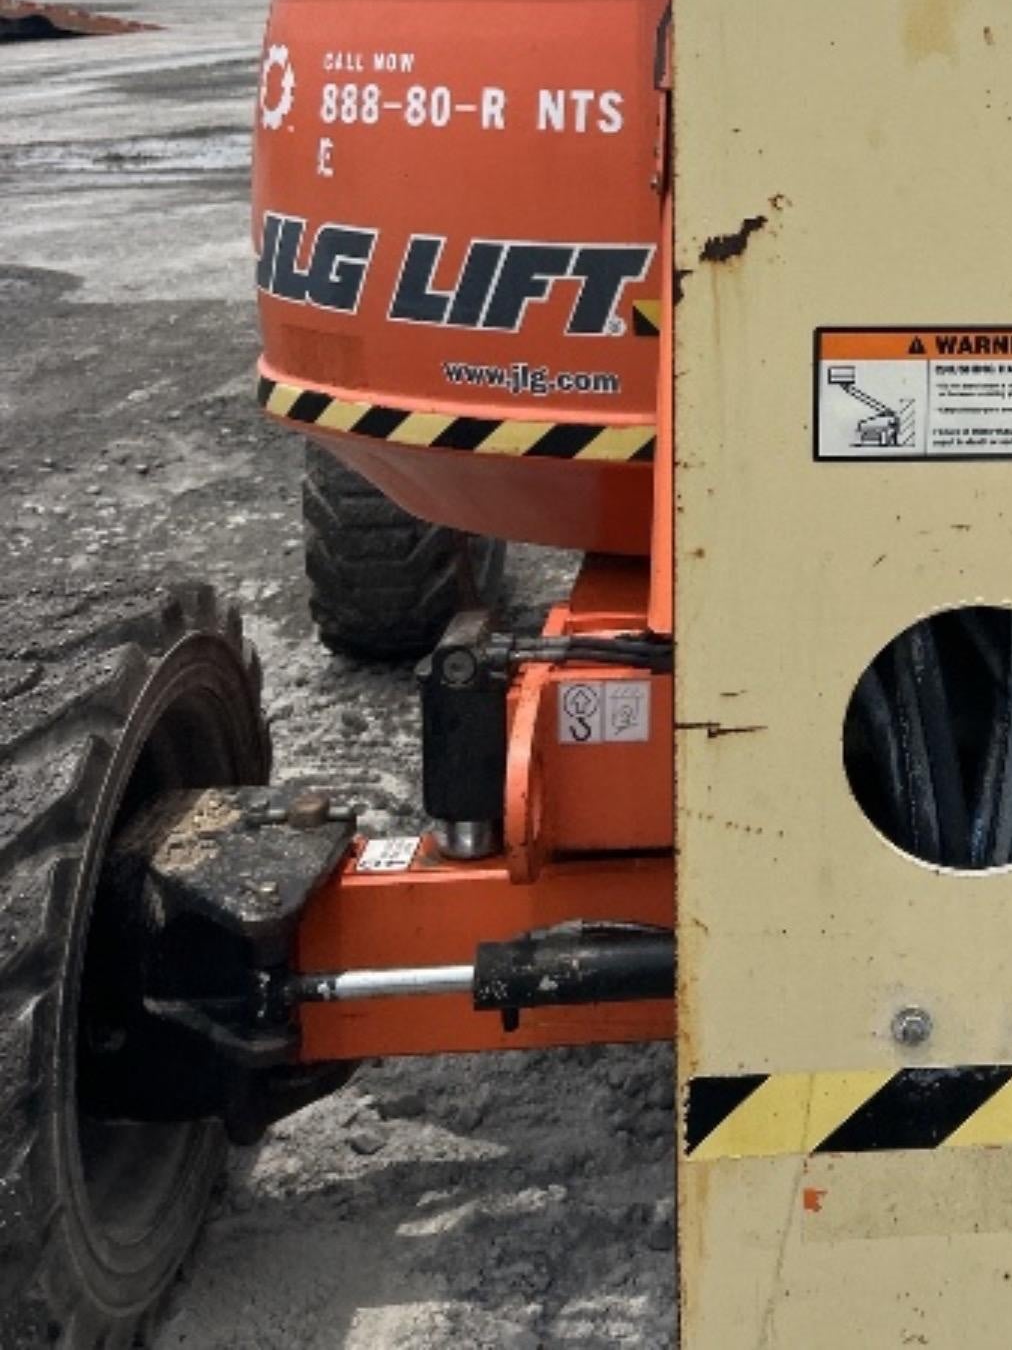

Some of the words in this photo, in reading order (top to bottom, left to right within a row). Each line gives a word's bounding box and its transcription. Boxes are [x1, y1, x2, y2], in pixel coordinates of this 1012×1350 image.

[323, 52, 364, 72] CALL
[373, 53, 415, 73] NOW
[320, 83, 505, 129] 888-80-R
[536, 90, 624, 133] NTS
[386, 234, 658, 337] LIFT
[442, 361, 621, 394] www.jlg.com
